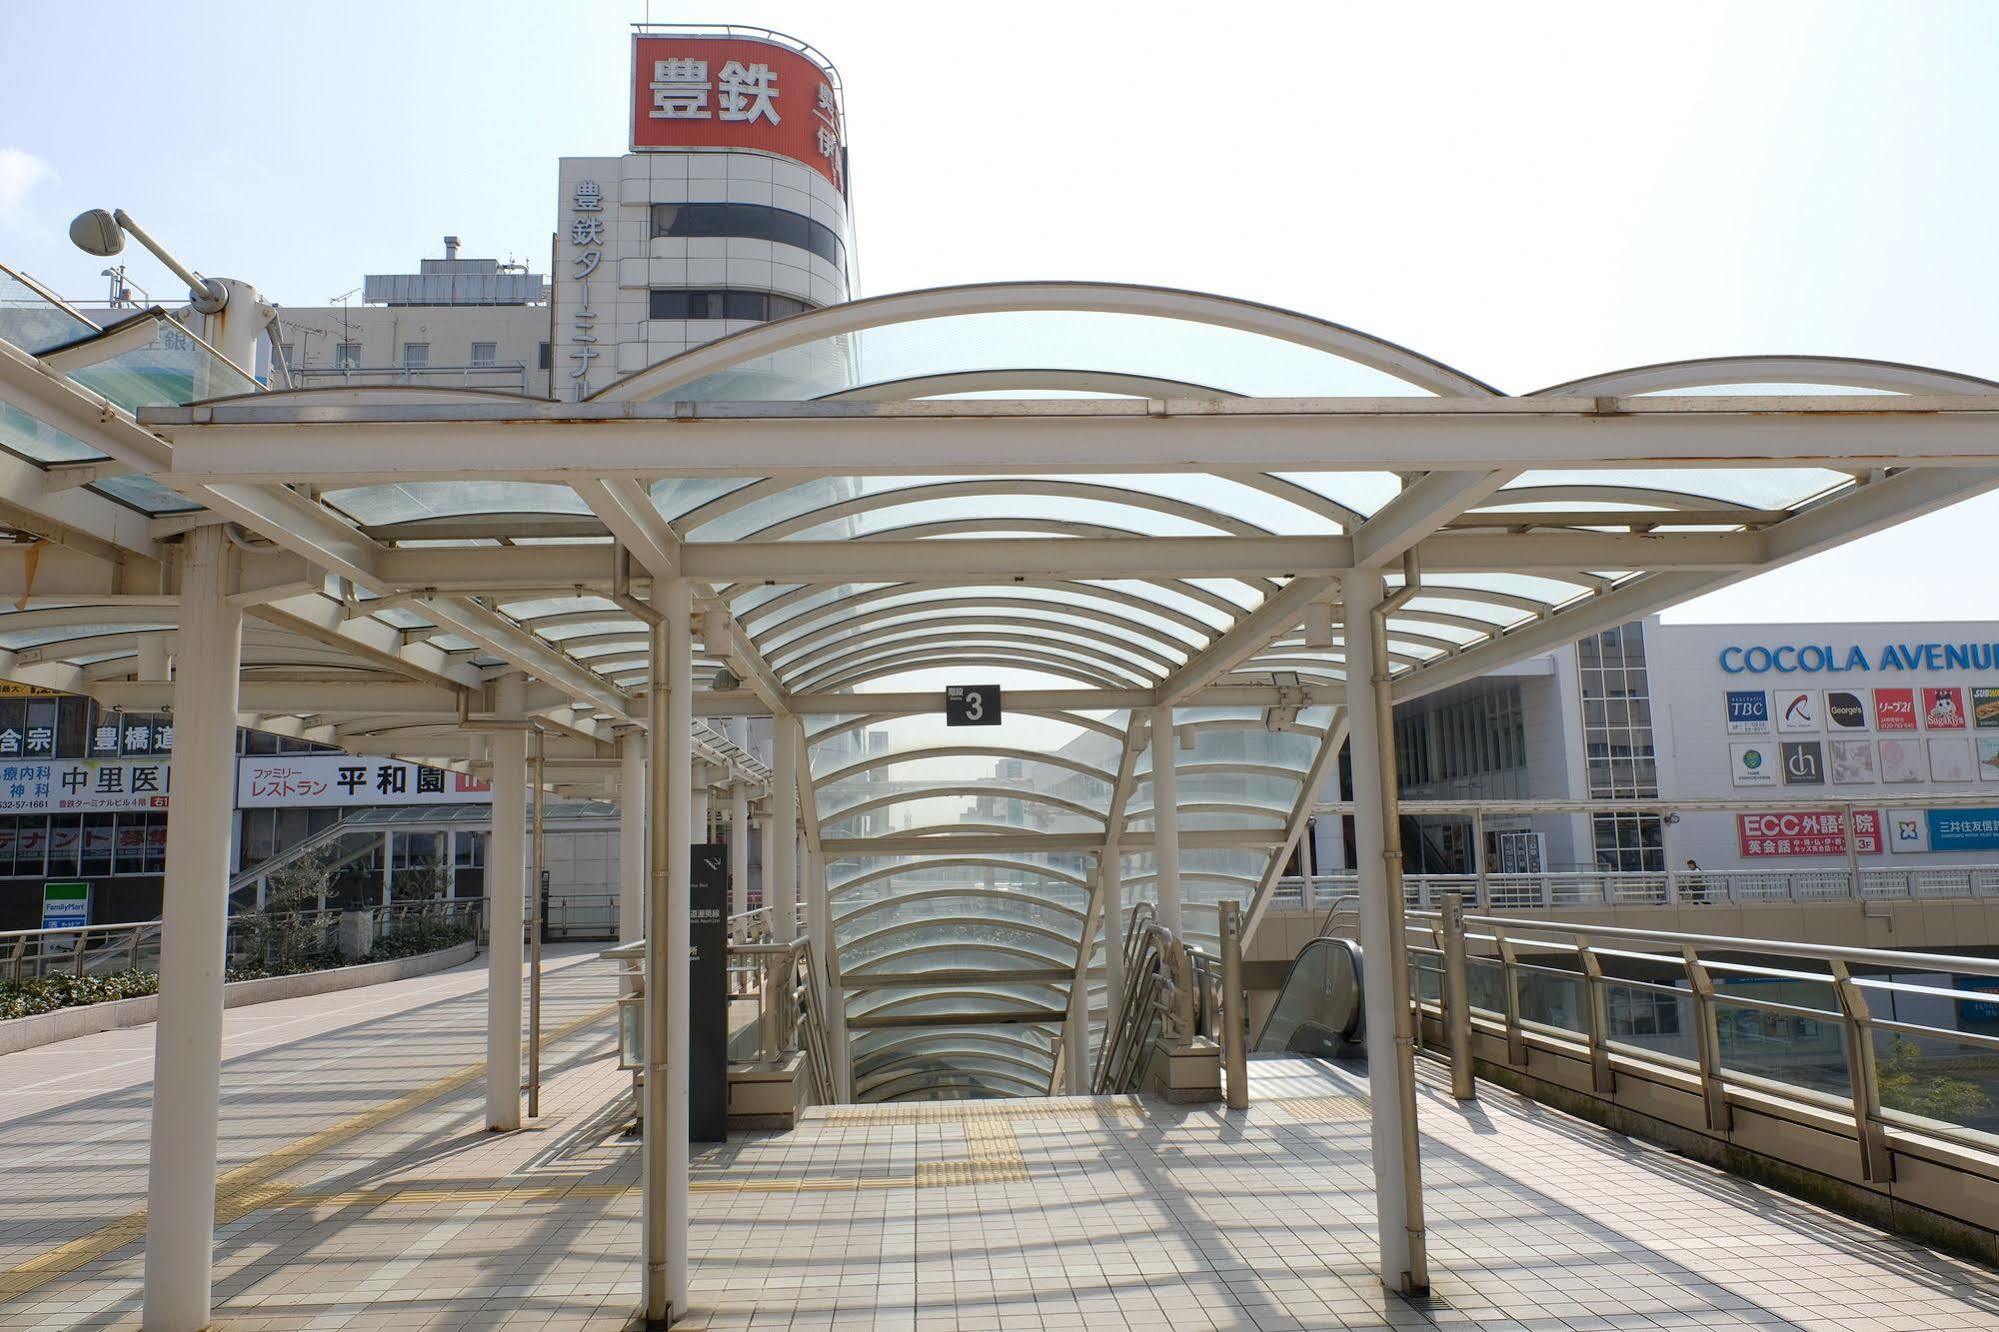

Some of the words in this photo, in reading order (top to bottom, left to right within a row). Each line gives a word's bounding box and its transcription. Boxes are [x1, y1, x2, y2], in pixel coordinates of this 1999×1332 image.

[649, 57, 782, 127] 豊鉄
[1719, 645, 1870, 674] COCOLA
[966, 692, 983, 720] 3
[1731, 702, 1763, 716] TBC
[62, 766, 170, 795] 中里医
[253, 768, 302, 780] ファミリー
[337, 764, 446, 796] 平和園
[252, 780, 327, 797] レストラン
[1744, 815, 1799, 837] ECC
[1858, 839, 1872, 849] 3F
[46, 903, 84, 911] FamilyMart
